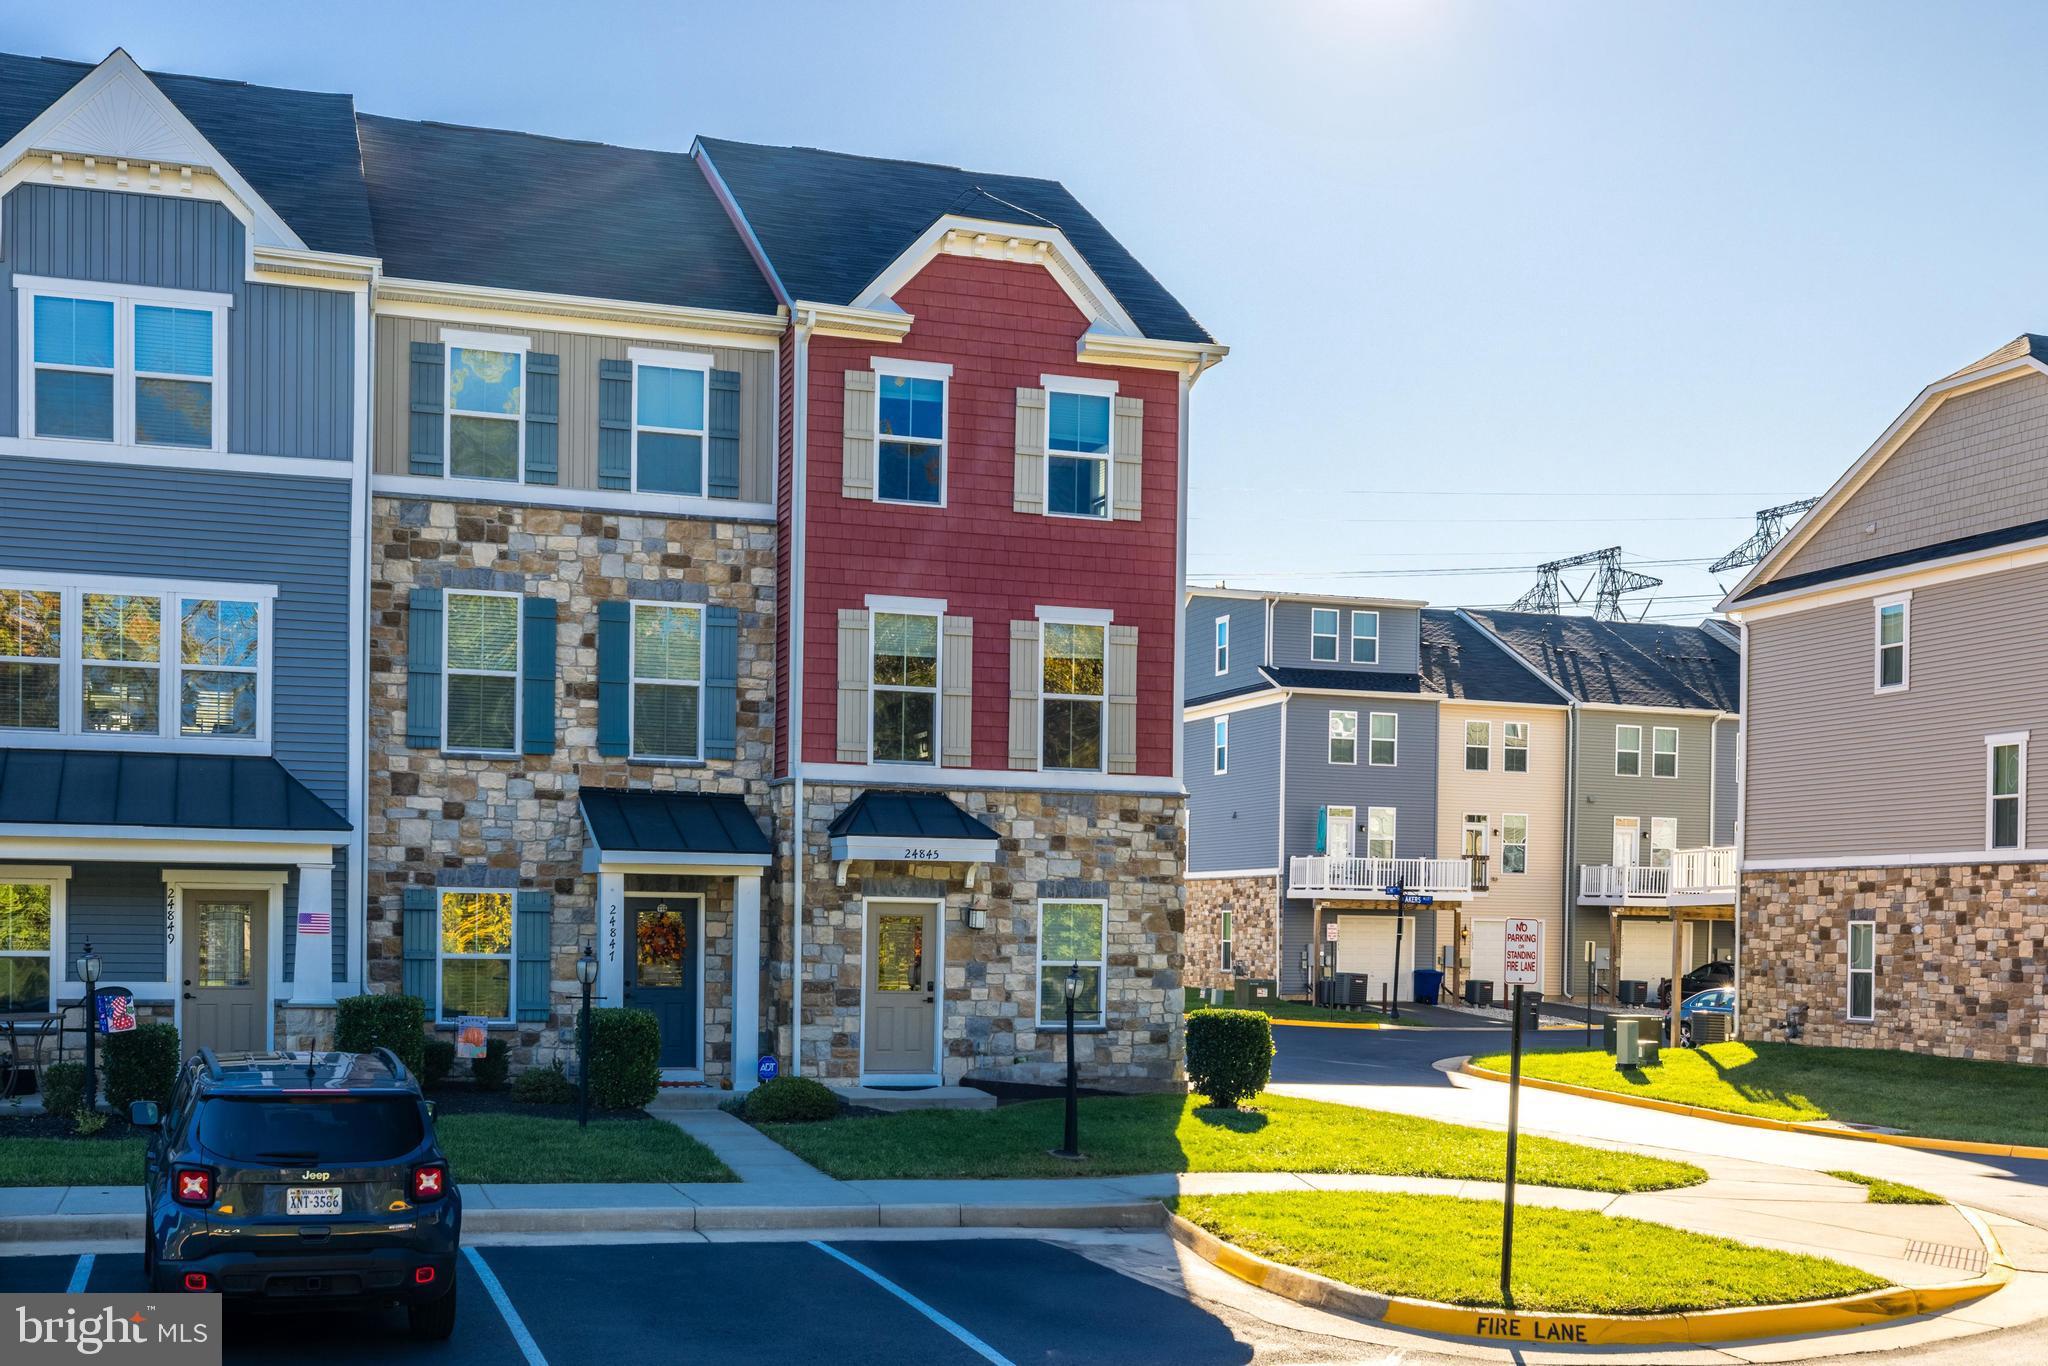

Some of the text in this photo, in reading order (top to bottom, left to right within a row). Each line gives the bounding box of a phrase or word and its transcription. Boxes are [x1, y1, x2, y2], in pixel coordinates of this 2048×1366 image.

[904, 848, 940, 860] 24845
[1404, 895, 1422, 904] AKERS
[167, 887, 175, 945] 24849
[1515, 922, 1528, 932] NO
[1507, 933, 1537, 943] PARKING
[1506, 950, 1536, 960] STANDING
[1506, 961, 1536, 972] FIRE LANE
[760, 1062, 776, 1072] ADT
[302, 1170, 330, 1182] Jeep
[290, 1195, 340, 1209] XNT-3586
[1476, 1317, 1588, 1343] FIRE LANE
